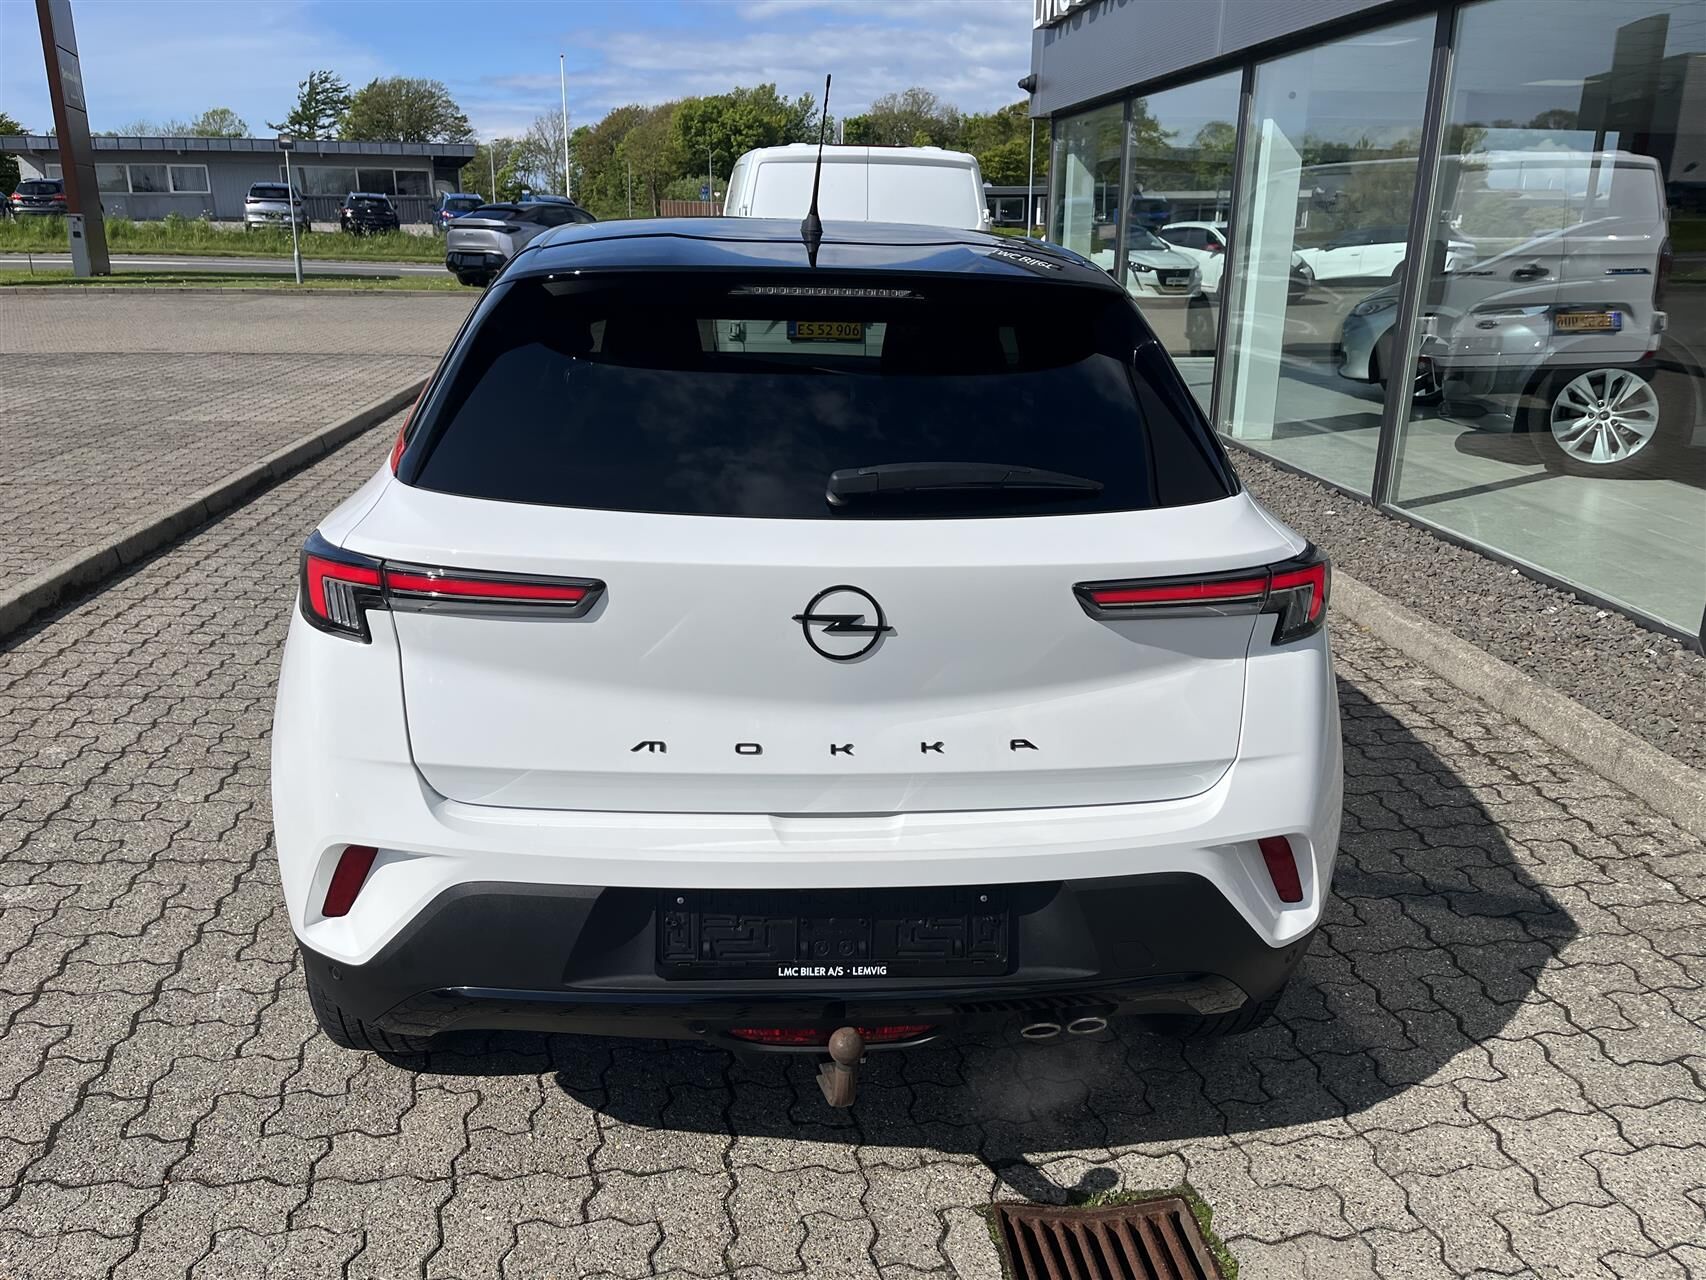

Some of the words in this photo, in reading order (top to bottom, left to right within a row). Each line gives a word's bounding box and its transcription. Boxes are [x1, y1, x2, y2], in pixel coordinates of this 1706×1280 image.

[797, 323, 815, 337] ES
[817, 323, 833, 337] 52
[836, 324, 860, 337] 906
[630, 738, 1039, 757] MOKKA
[778, 967, 799, 976] LMC
[800, 967, 826, 976] BILER
[827, 966, 844, 977] A/S
[852, 966, 887, 976] LEMVIG
